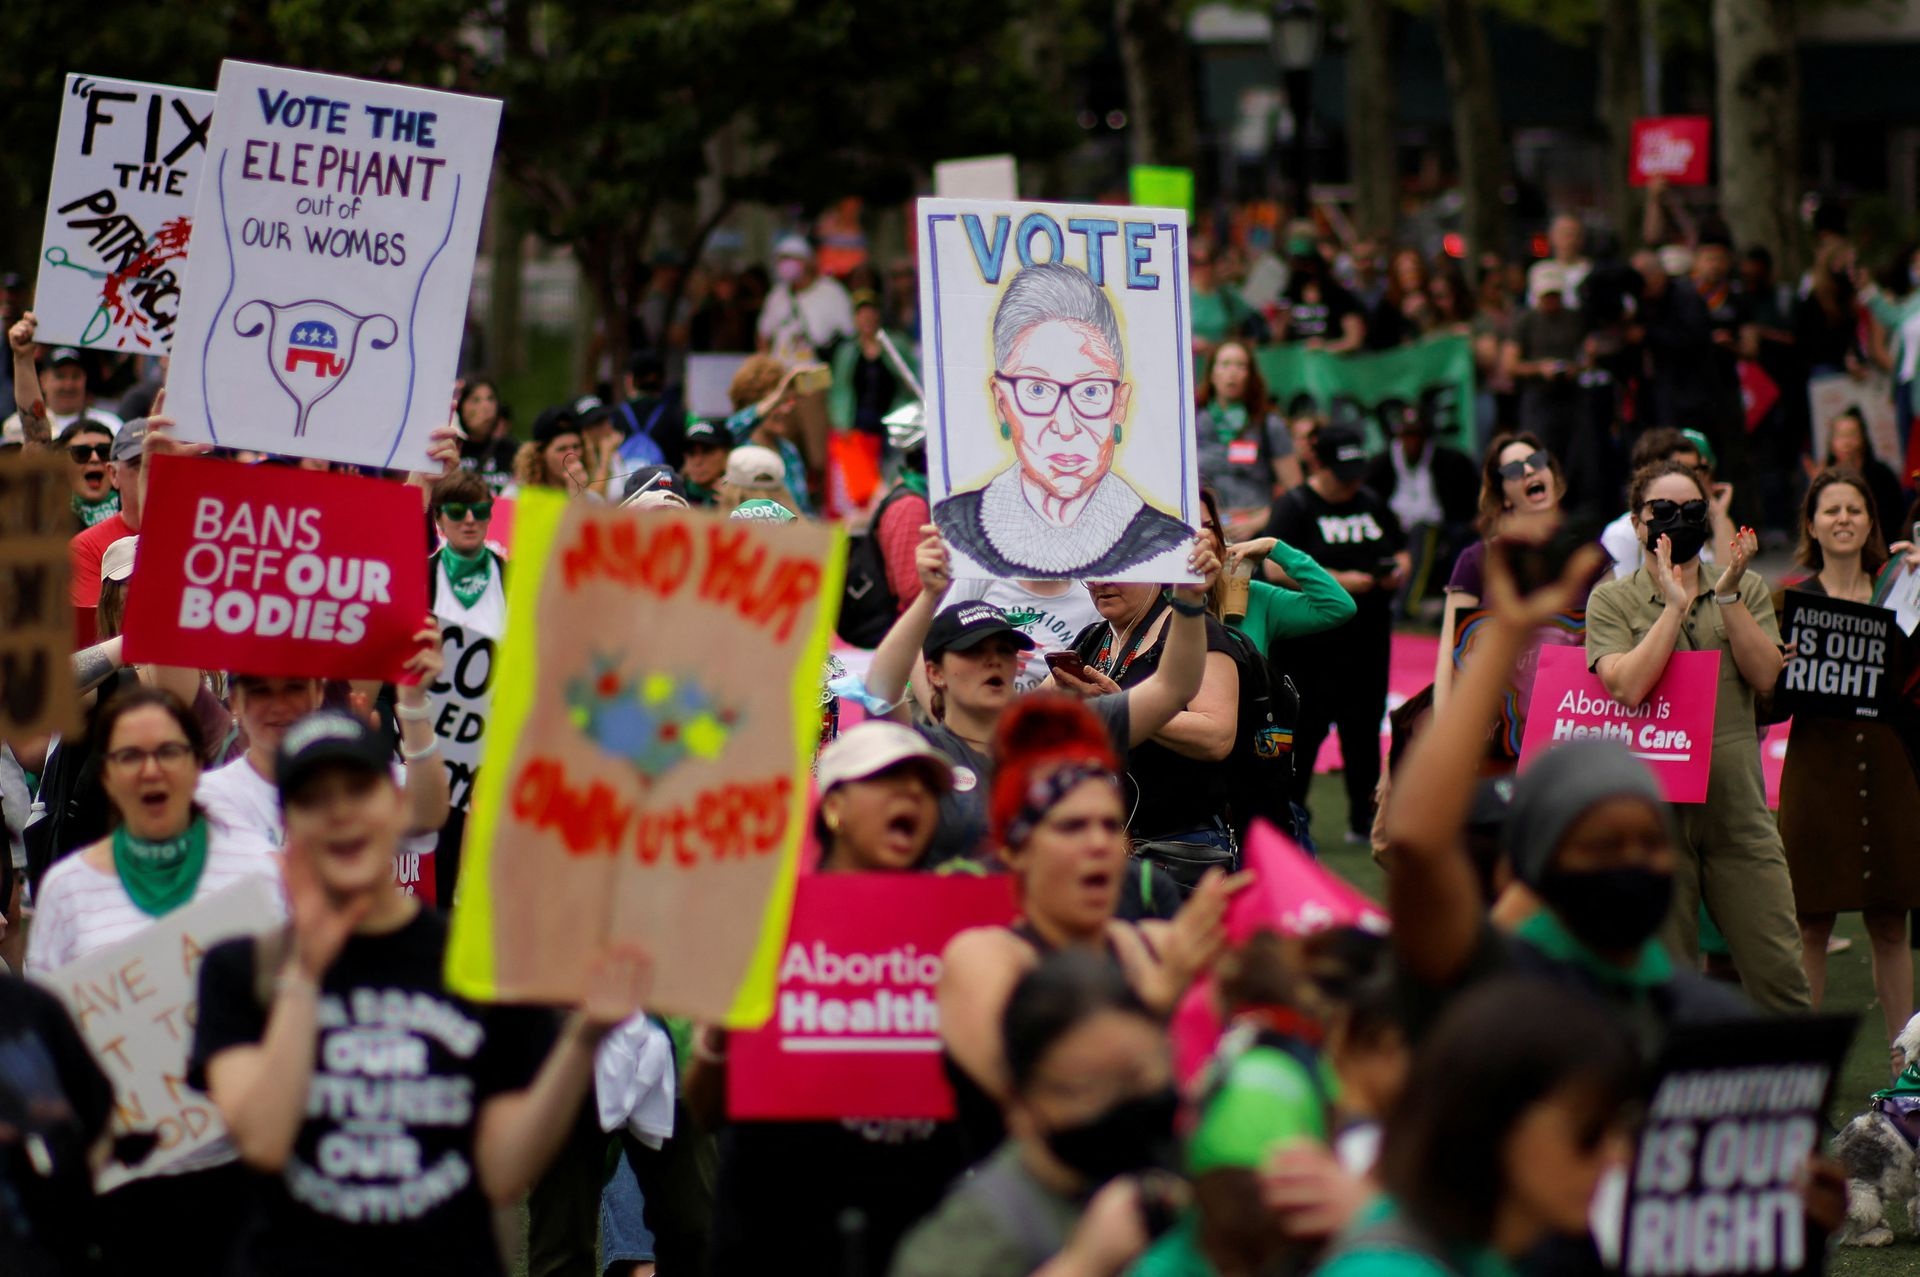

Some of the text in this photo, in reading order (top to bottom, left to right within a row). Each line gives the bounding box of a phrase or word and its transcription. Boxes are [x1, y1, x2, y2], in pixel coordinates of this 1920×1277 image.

[258, 87, 438, 148] VOTE THE
[113, 163, 188, 197] THE
[242, 140, 446, 201] ELEPHANT
[296, 196, 362, 220] out of
[242, 217, 406, 267] OUR WOMBS
[961, 212, 1160, 291] VOTE
[193, 497, 321, 550] BANS
[184, 543, 391, 604] OFF OUR
[178, 587, 371, 645] BODIES
[960, 611, 990, 625] Health
[1793, 606, 1887, 638] ABORTION
[1790, 626, 1886, 665] IS OUR
[1785, 657, 1884, 699] RIGHT
[1557, 689, 1671, 719] Abortion is
[1639, 724, 1692, 750] Care.
[779, 940, 943, 985] Abortio
[780, 988, 940, 1033] Health
[322, 1030, 429, 1076] OUR
[318, 1133, 421, 1178] OUR
[1638, 1117, 1816, 1192] IS OUR
[1627, 1191, 1806, 1276] RIGHT
